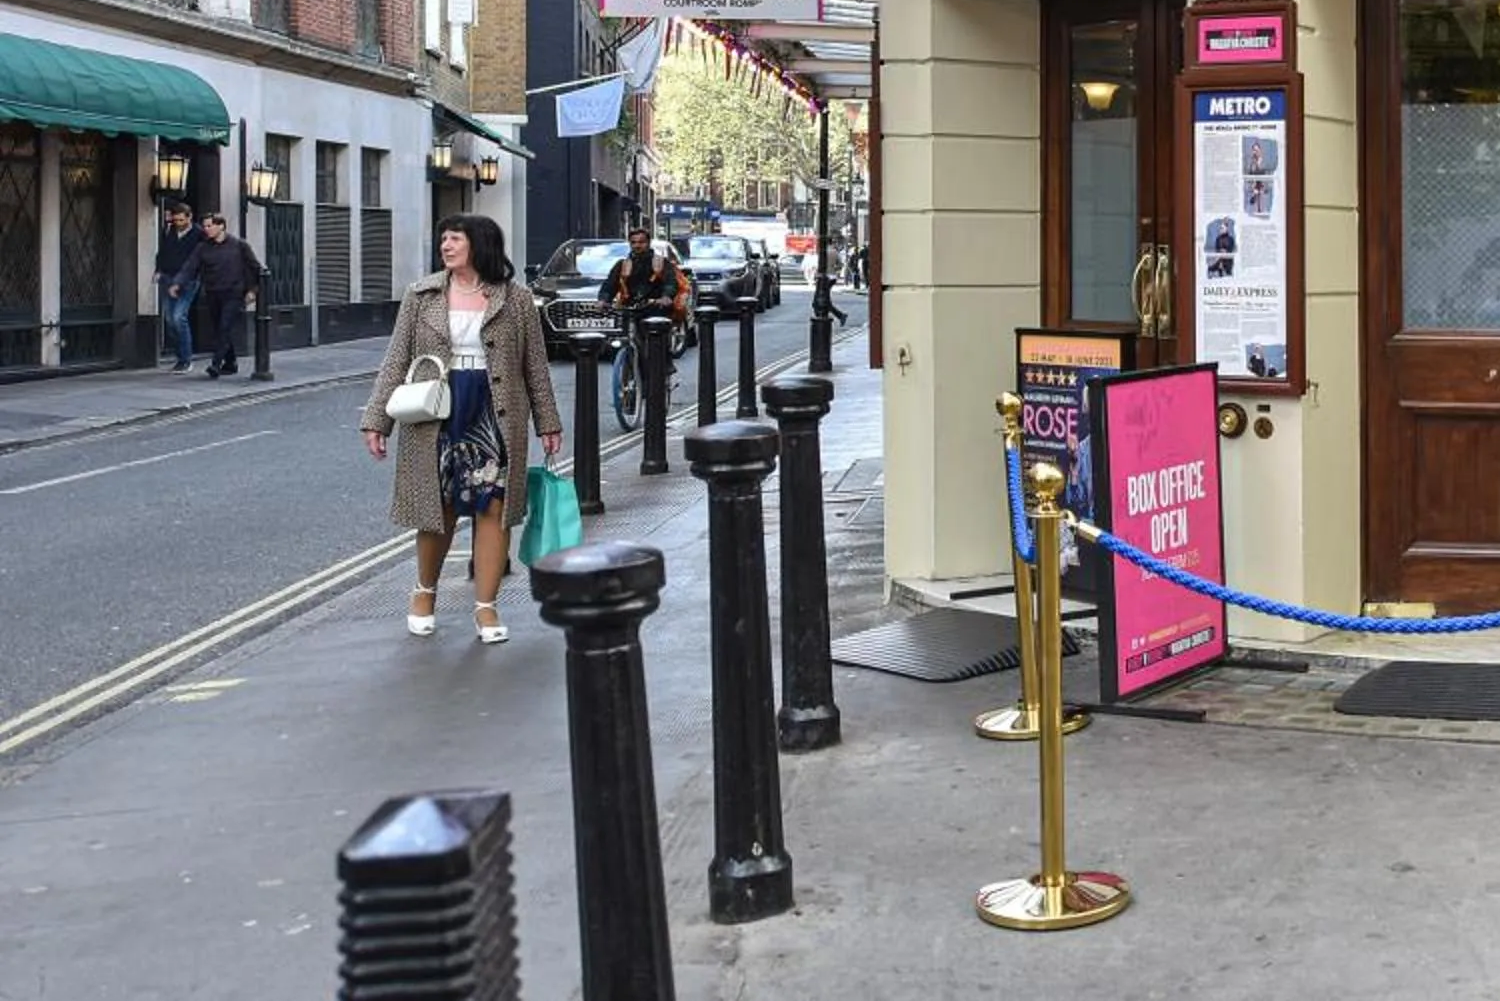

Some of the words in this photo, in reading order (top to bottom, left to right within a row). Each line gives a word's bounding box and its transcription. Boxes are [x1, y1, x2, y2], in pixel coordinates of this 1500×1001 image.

[663, 0, 727, 8] COURTROOM
[1209, 96, 1271, 116] METRO
[1023, 404, 1079, 438] ROSE
[1127, 470, 1158, 517] BOX
[1159, 460, 1207, 508] OFFICE
[1151, 506, 1188, 554] OPEN
